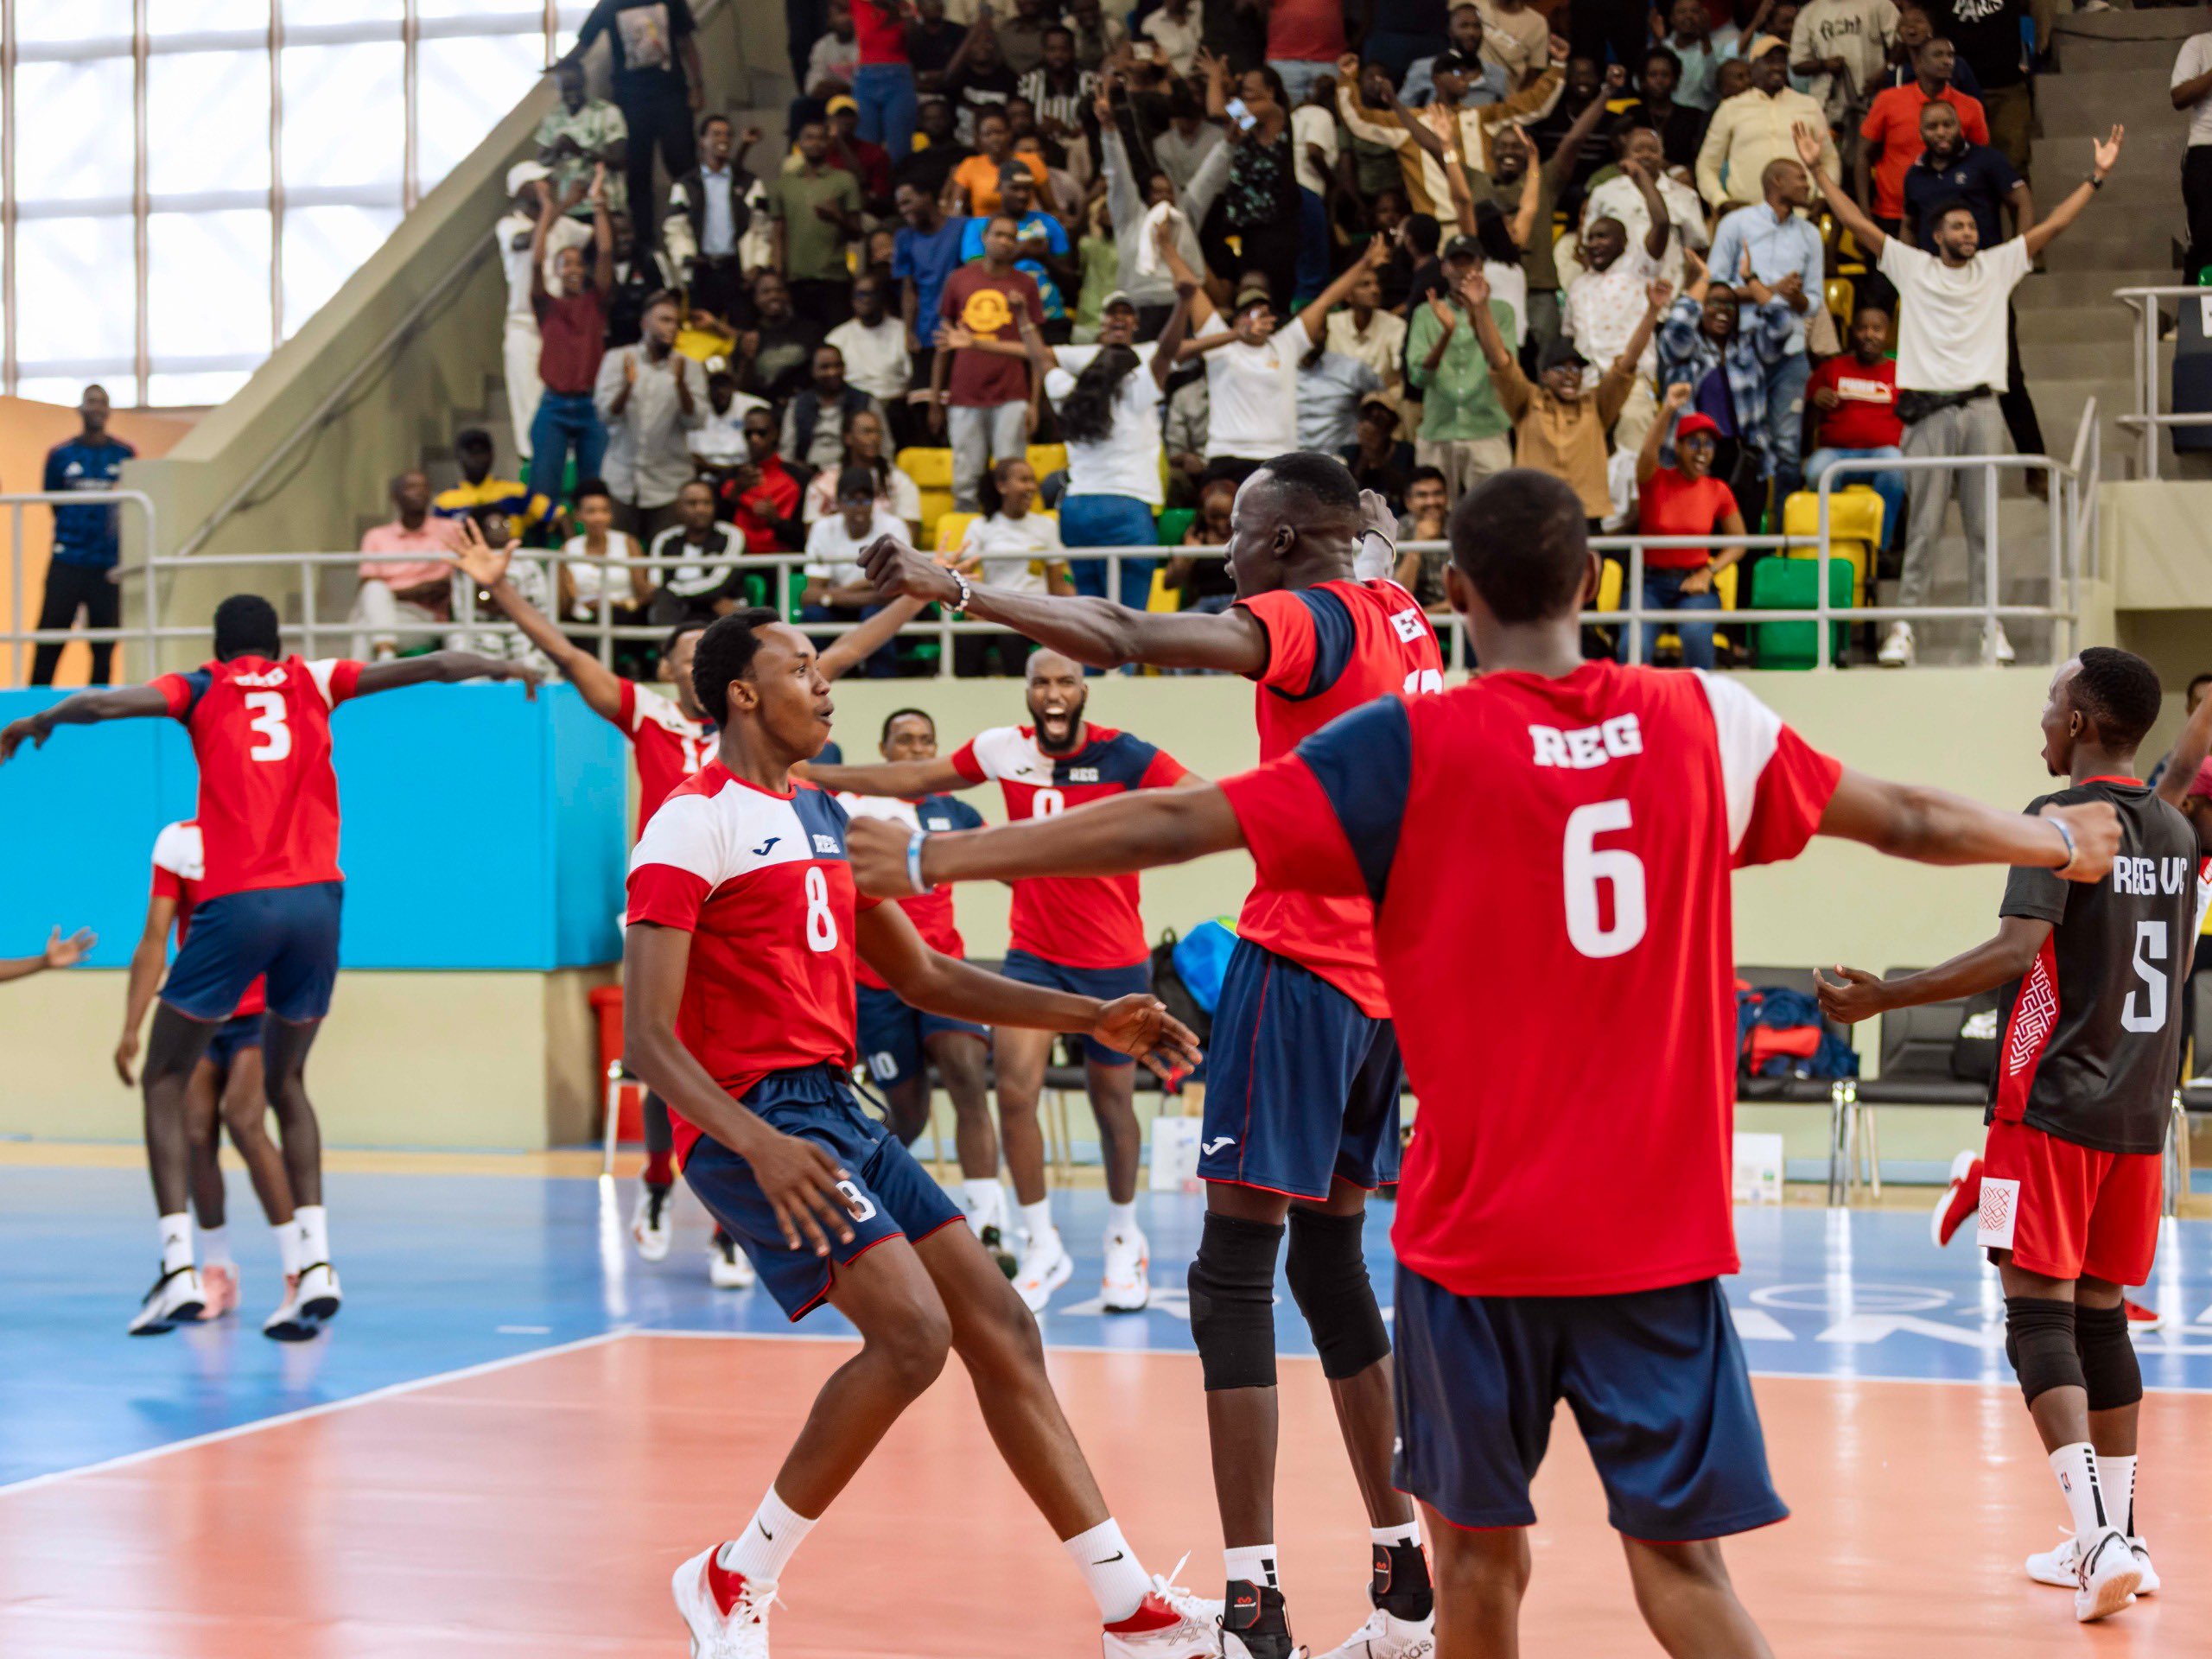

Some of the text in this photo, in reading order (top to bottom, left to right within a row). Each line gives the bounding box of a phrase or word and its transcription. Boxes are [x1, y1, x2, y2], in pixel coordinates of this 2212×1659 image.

[245, 690, 292, 762] 3
[1528, 712, 1643, 769] REG
[804, 867, 838, 952] 8
[1562, 798, 1647, 959] 6
[2113, 855, 2188, 895] REG VC
[2120, 921, 2167, 1033] 5
[868, 1042, 899, 1082] 10
